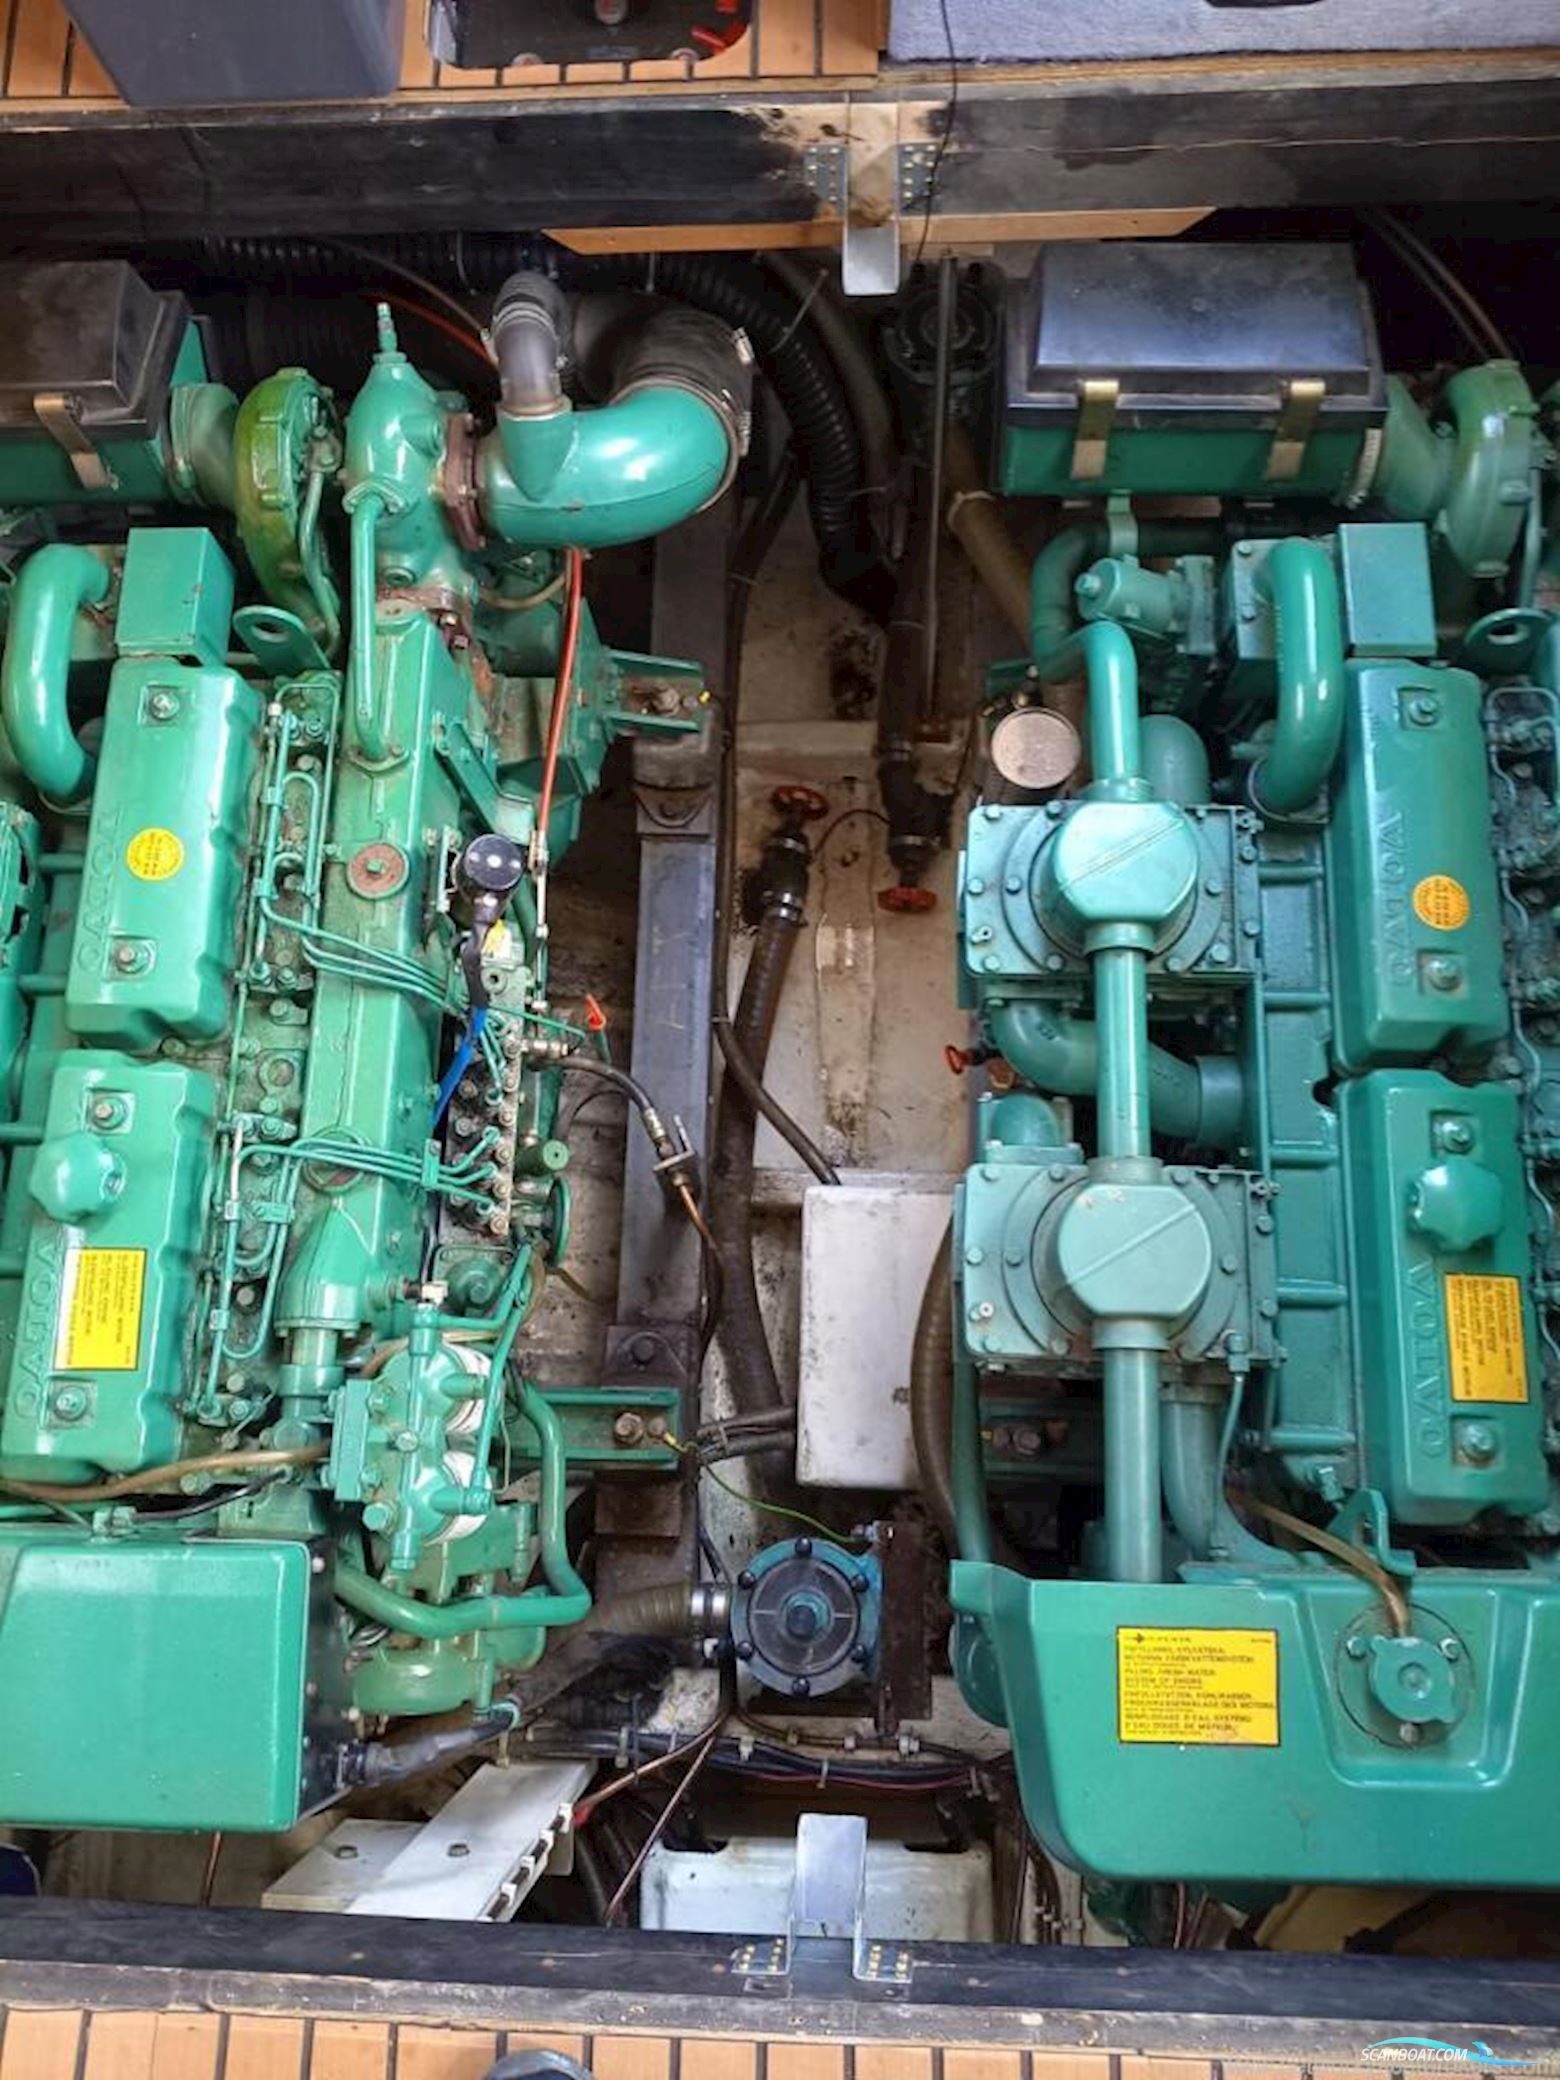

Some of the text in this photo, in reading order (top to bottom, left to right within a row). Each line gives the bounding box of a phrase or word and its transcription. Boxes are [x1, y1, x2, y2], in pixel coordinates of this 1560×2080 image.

[1379, 812, 1414, 985] VOLVO
[13, 1243, 57, 1419] VOLVO
[1408, 1260, 1444, 1457] VOLVO
